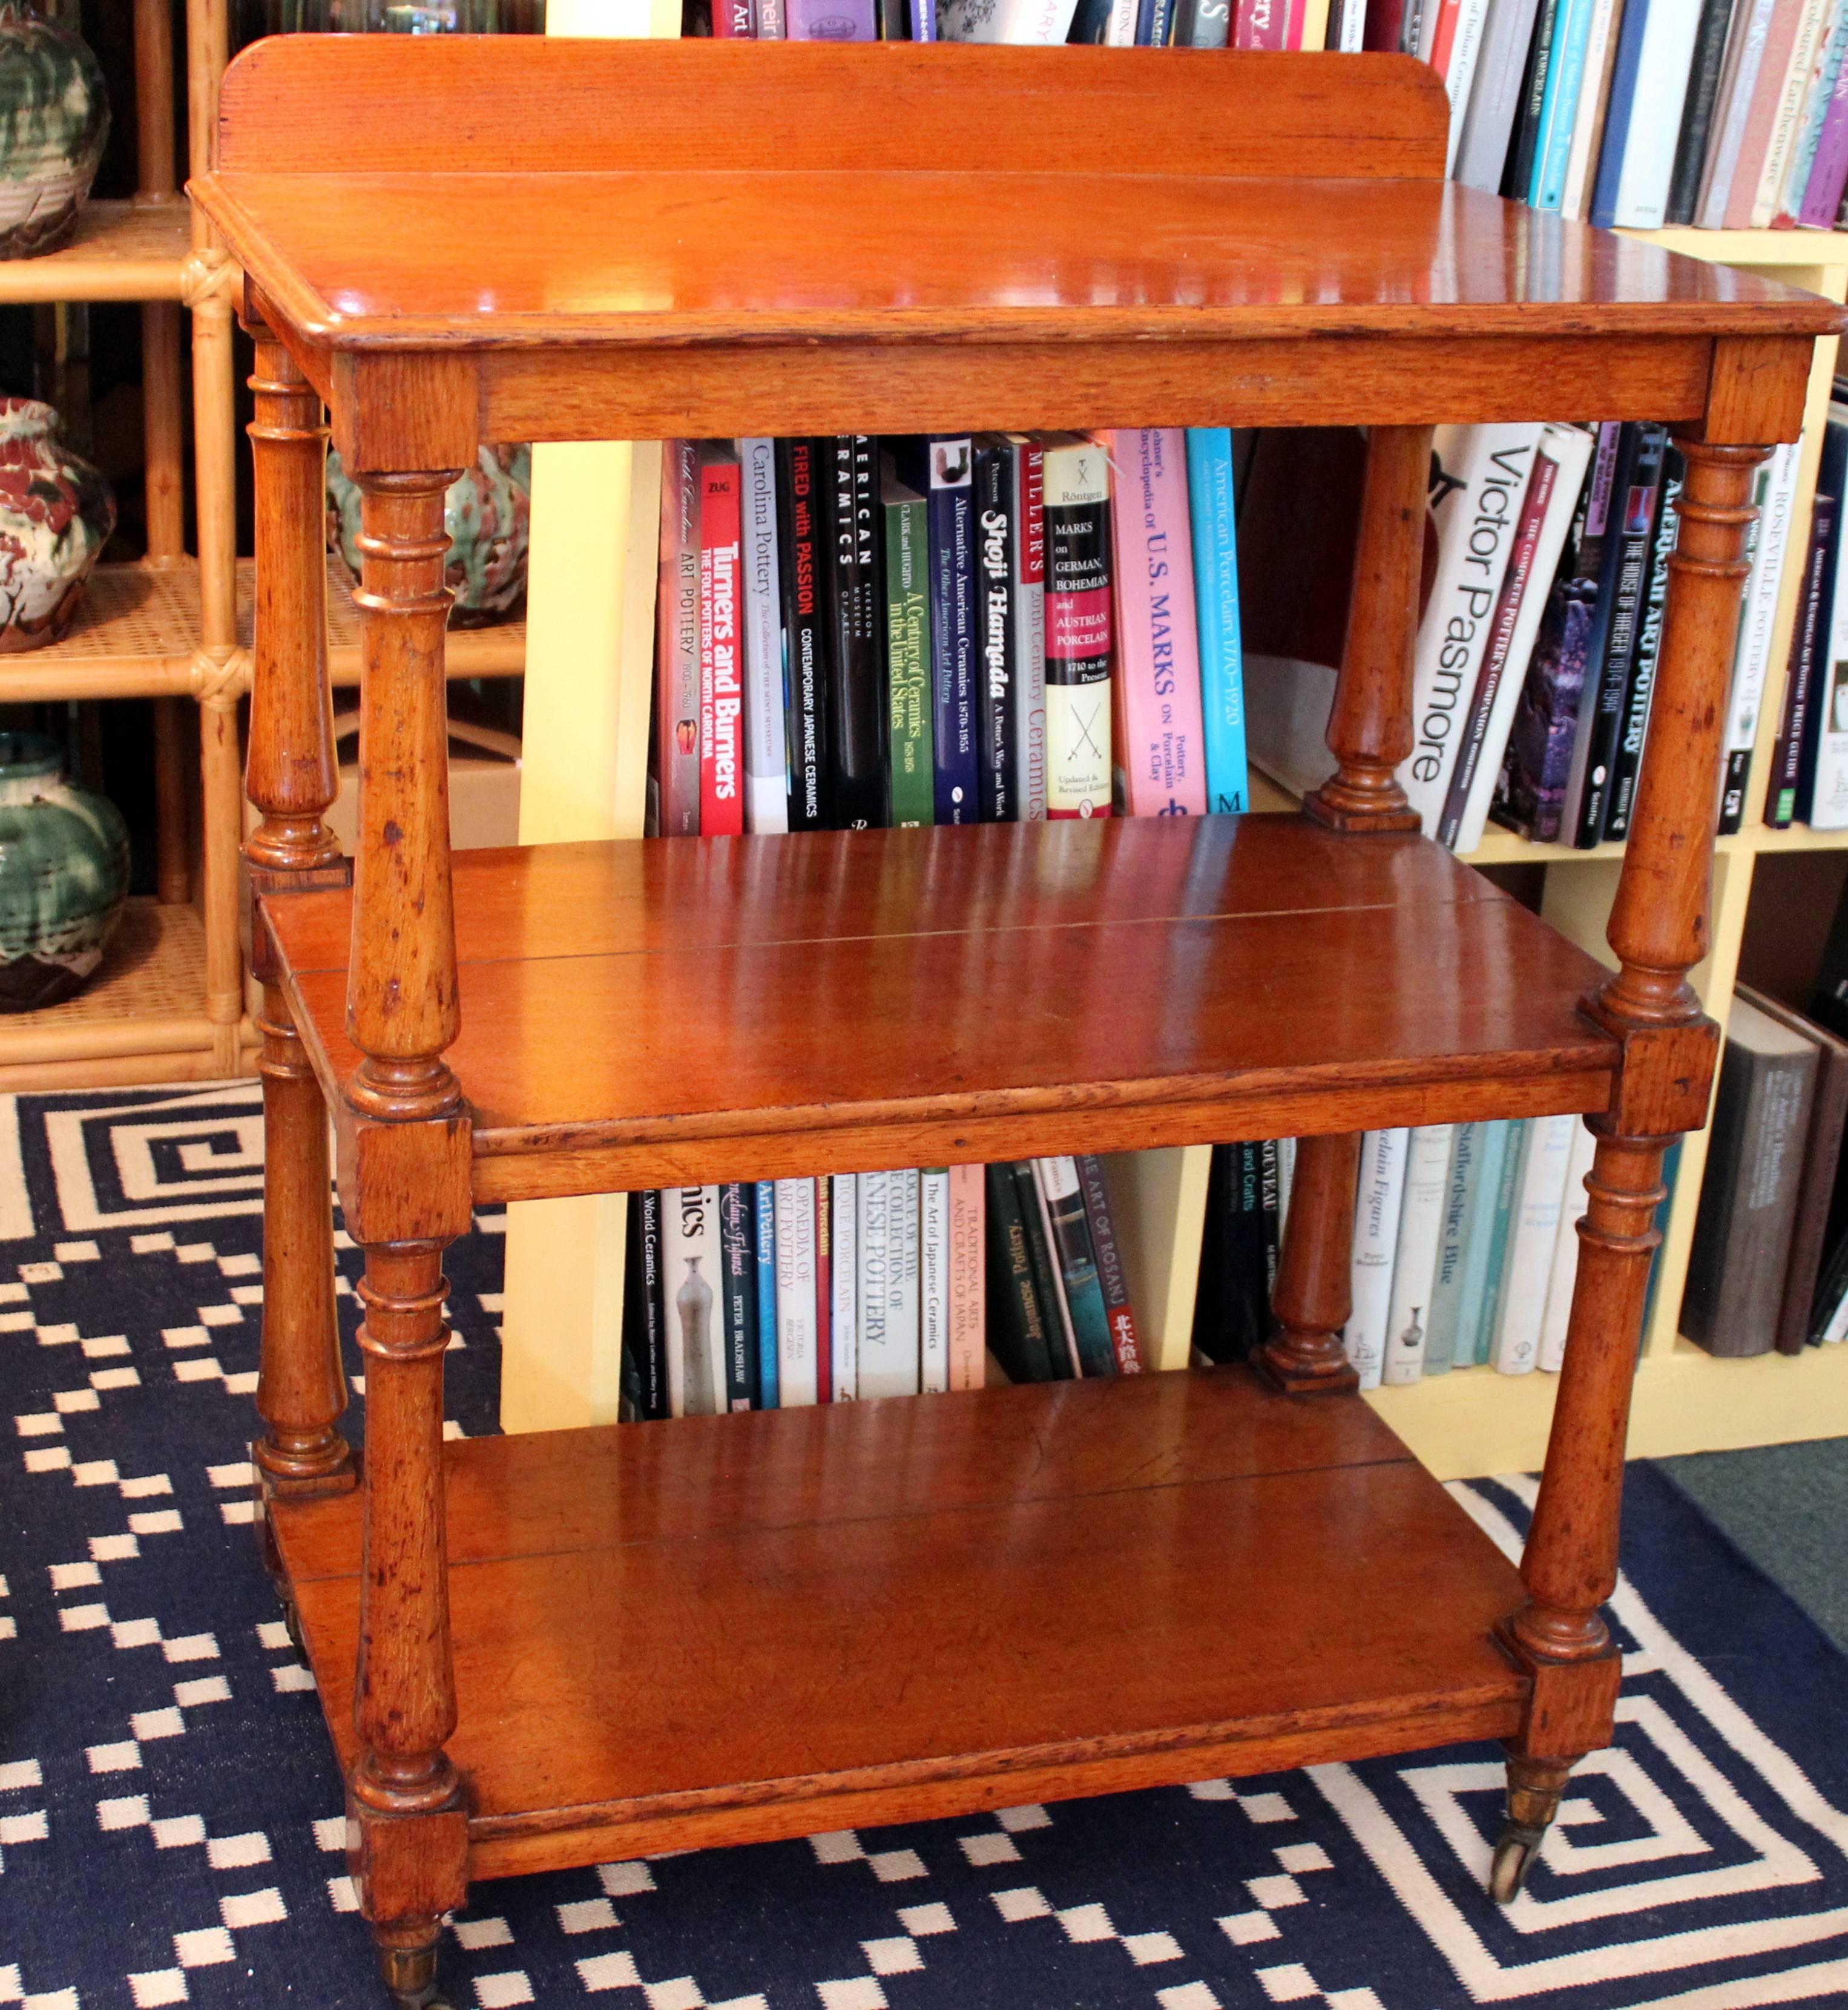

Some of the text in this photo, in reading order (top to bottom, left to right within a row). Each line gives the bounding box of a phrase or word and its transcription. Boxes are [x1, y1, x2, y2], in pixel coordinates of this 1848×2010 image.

[733, 4, 749, 32] Art
[1460, 18, 1478, 57] Italian
[1530, 50, 1550, 116] PORCELAIN
[708, 481, 730, 494] ZUG
[1028, 451, 1044, 572] MILLER'S
[1062, 491, 1103, 505] Röntgen
[752, 444, 773, 597] Carolina Pottery
[1055, 521, 1094, 535] MARKS
[1055, 545, 1068, 554] on
[1214, 458, 1236, 633] American Porcelain
[1527, 517, 1542, 541] THE
[1758, 491, 1789, 609] ROSEVILLE
[680, 552, 695, 579] ART
[1055, 557, 1102, 573] GERMAN,
[1056, 574, 1108, 591] BOHEMIAN
[1509, 543, 1534, 605] COMPLETE
[680, 588, 695, 655] POTTERY
[794, 445, 817, 818] FIRED with PASSION CONTEMPORARY JAPANESE CERAMICS
[901, 504, 926, 738] CLARK and HUGHTO A Century of Ceramics
[940, 547, 953, 704] The Other American Art Pottery
[955, 496, 970, 753] Alternative American Ceramics 1870-1955
[1030, 589, 1043, 627] 20th
[1056, 597, 1074, 609] and
[1056, 612, 1107, 629] AUSTRIAN
[1146, 531, 1175, 724] U.S. MARKS ON
[1411, 445, 1531, 783] Victor Pasmore
[1601, 541, 1645, 712] THE HOUSE OF HAEGER 1914-1944
[1640, 605, 1663, 652] ART
[701, 547, 714, 760] THE FOLK POTTERS OF NORTH CAROLINA
[890, 602, 909, 729] in the United States
[980, 462, 1010, 817] Peterson Shoji Hamada A Potter's Way and Work
[1057, 628, 1108, 646] PORCELAIN
[1068, 659, 1108, 672] 1710 to the
[1490, 606, 1519, 668] POTTER'S
[1746, 609, 1769, 679] POTTERY
[713, 540, 741, 800] Turners and Burners
[1080, 670, 1108, 683] Present
[1472, 669, 1501, 740] COMPANION
[1623, 658, 1654, 754] POTTERY
[1790, 704, 1805, 738] PRICE
[1028, 708, 1047, 822] Ceramics
[1057, 774, 1089, 786] Updated
[1149, 742, 1162, 781] & Clay
[1163, 731, 1176, 789] Porcelain
[1176, 734, 1186, 782] Pottery,
[1785, 741, 1800, 778] GUIDE
[1058, 786, 1087, 794] Revised
[1218, 790, 1241, 813] M
[1088, 1181, 1112, 1236] ART OF
[1243, 1149, 1256, 1212] and Crafts
[1367, 1178, 1390, 1238] Figures
[643, 1197, 656, 1231] World
[757, 1180, 774, 1265] Art Pottery
[779, 1180, 794, 1290] ART POTTERY
[820, 1201, 830, 1256] Porcelain
[889, 1184, 903, 1285] COLLECTION
[643, 1233, 657, 1286] Ceramics
[723, 1228, 752, 1276] Figures
[795, 1261, 810, 1283] OF
[838, 1229, 851, 1313] PORCELAIN
[906, 1221, 916, 1282] OF THE
[925, 1182, 940, 1349] The Art of Japanese Ceramics
[955, 1198, 966, 1342] AND CRAFTS OF JAPAN
[967, 1206, 978, 1329] TRADITIONAL ARTS
[1441, 1245, 1459, 1284] Blue
[866, 1244, 886, 1345] POTTERY
[889, 1289, 903, 1312] OF
[1019, 1278, 1042, 1339] Japanese
[732, 1295, 745, 1384] PETER BRADSHAW
